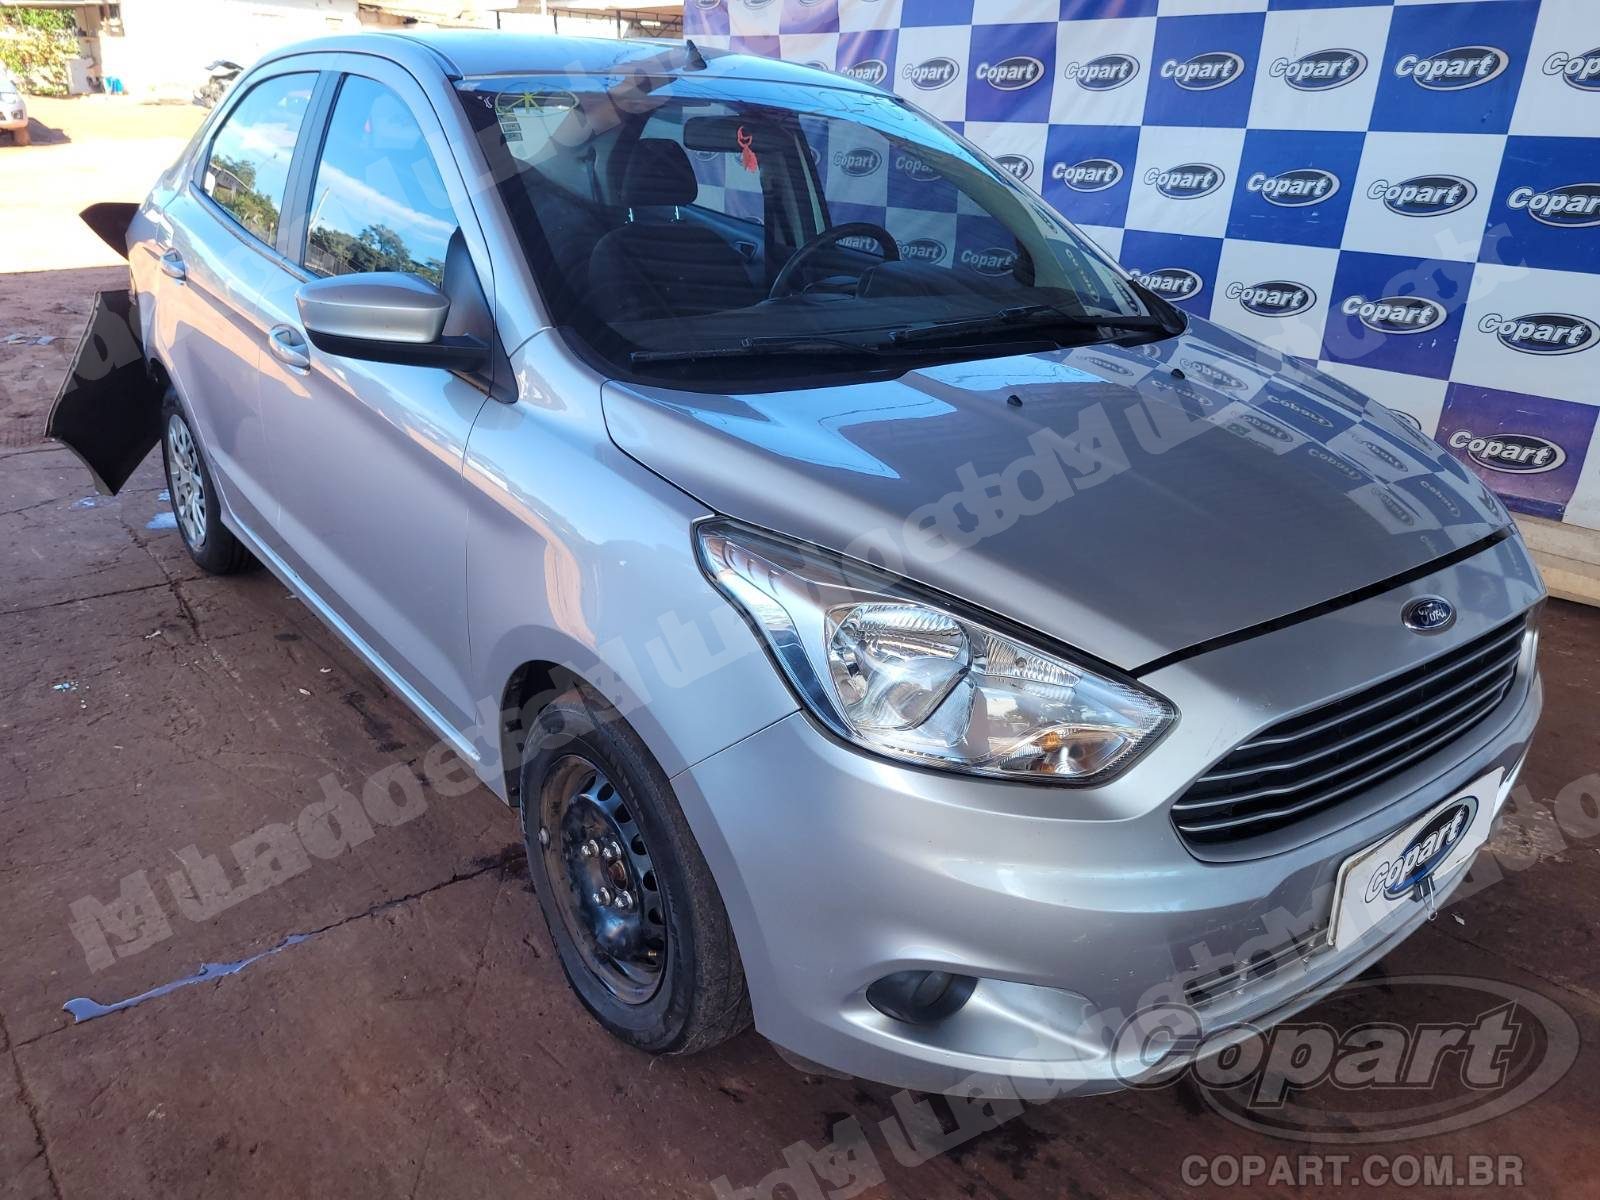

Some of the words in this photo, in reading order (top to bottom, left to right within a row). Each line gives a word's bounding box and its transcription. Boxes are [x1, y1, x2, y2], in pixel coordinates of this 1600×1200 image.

[902, 62, 953, 83] Copart
[975, 62, 1037, 83] Copart
[1064, 61, 1130, 83] Copart
[1160, 60, 1234, 80] Copart
[1269, 52, 1354, 81] Copart
[1394, 50, 1497, 81] Copart
[832, 151, 874, 168] Copart
[1052, 162, 1117, 184] Copart
[1144, 167, 1213, 190] Copart
[1246, 171, 1329, 198] Copart
[1367, 179, 1462, 208] Copart
[1507, 186, 1600, 217] Copar
[961, 249, 1013, 268] Copart
[1226, 280, 1304, 309] Copart
[1342, 295, 1435, 327] Copart
[1478, 313, 1586, 348] Copart
[1448, 430, 1554, 467] Copart
[1365, 804, 1466, 903] Copart
